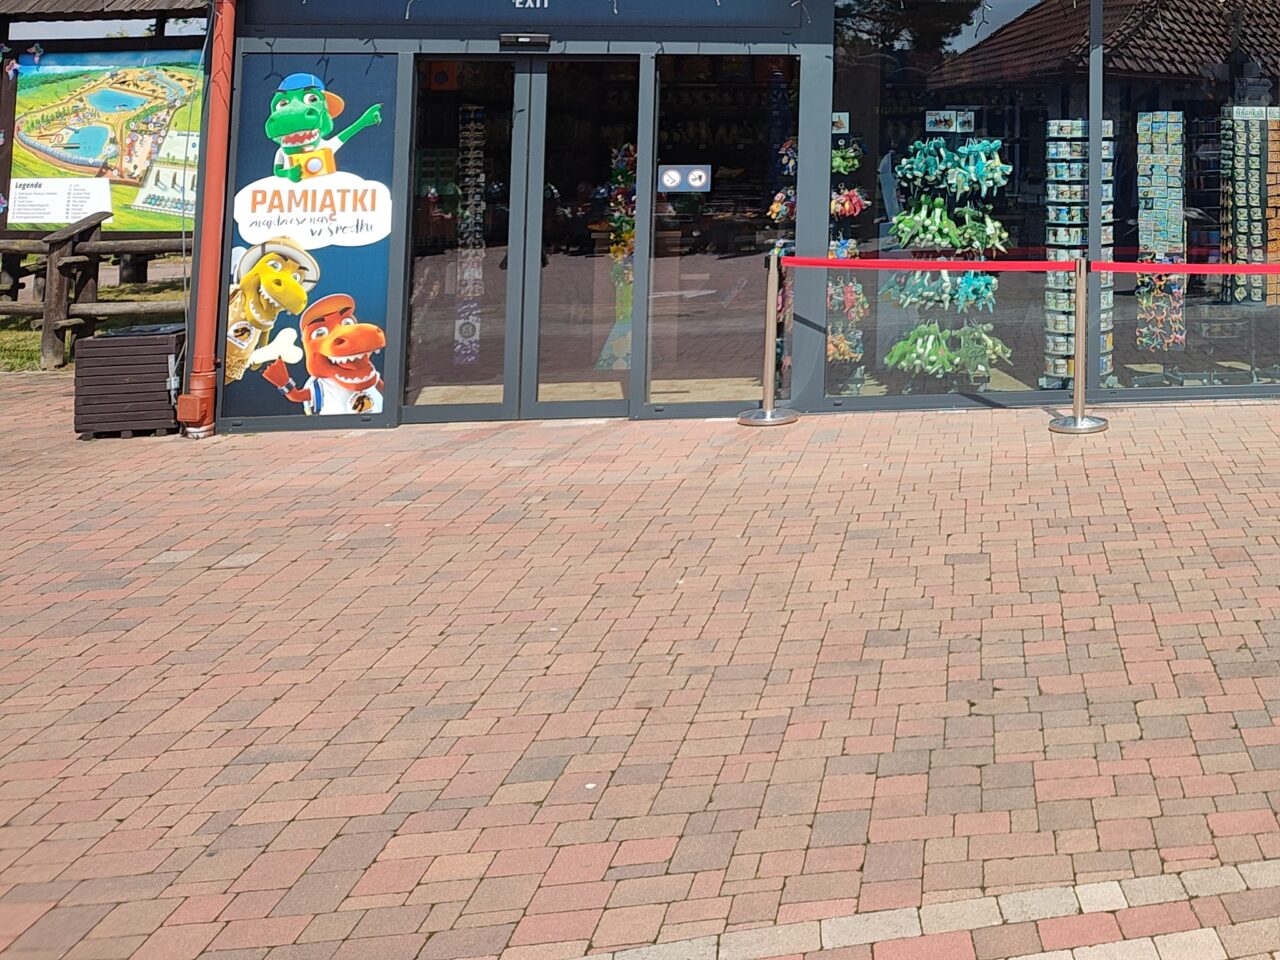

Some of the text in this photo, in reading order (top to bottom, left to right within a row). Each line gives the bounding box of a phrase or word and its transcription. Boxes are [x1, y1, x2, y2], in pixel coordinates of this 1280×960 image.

[15, 182, 42, 190] Legenda
[250, 188, 377, 221] PAMIĄTKI
[310, 228, 322, 236] w
